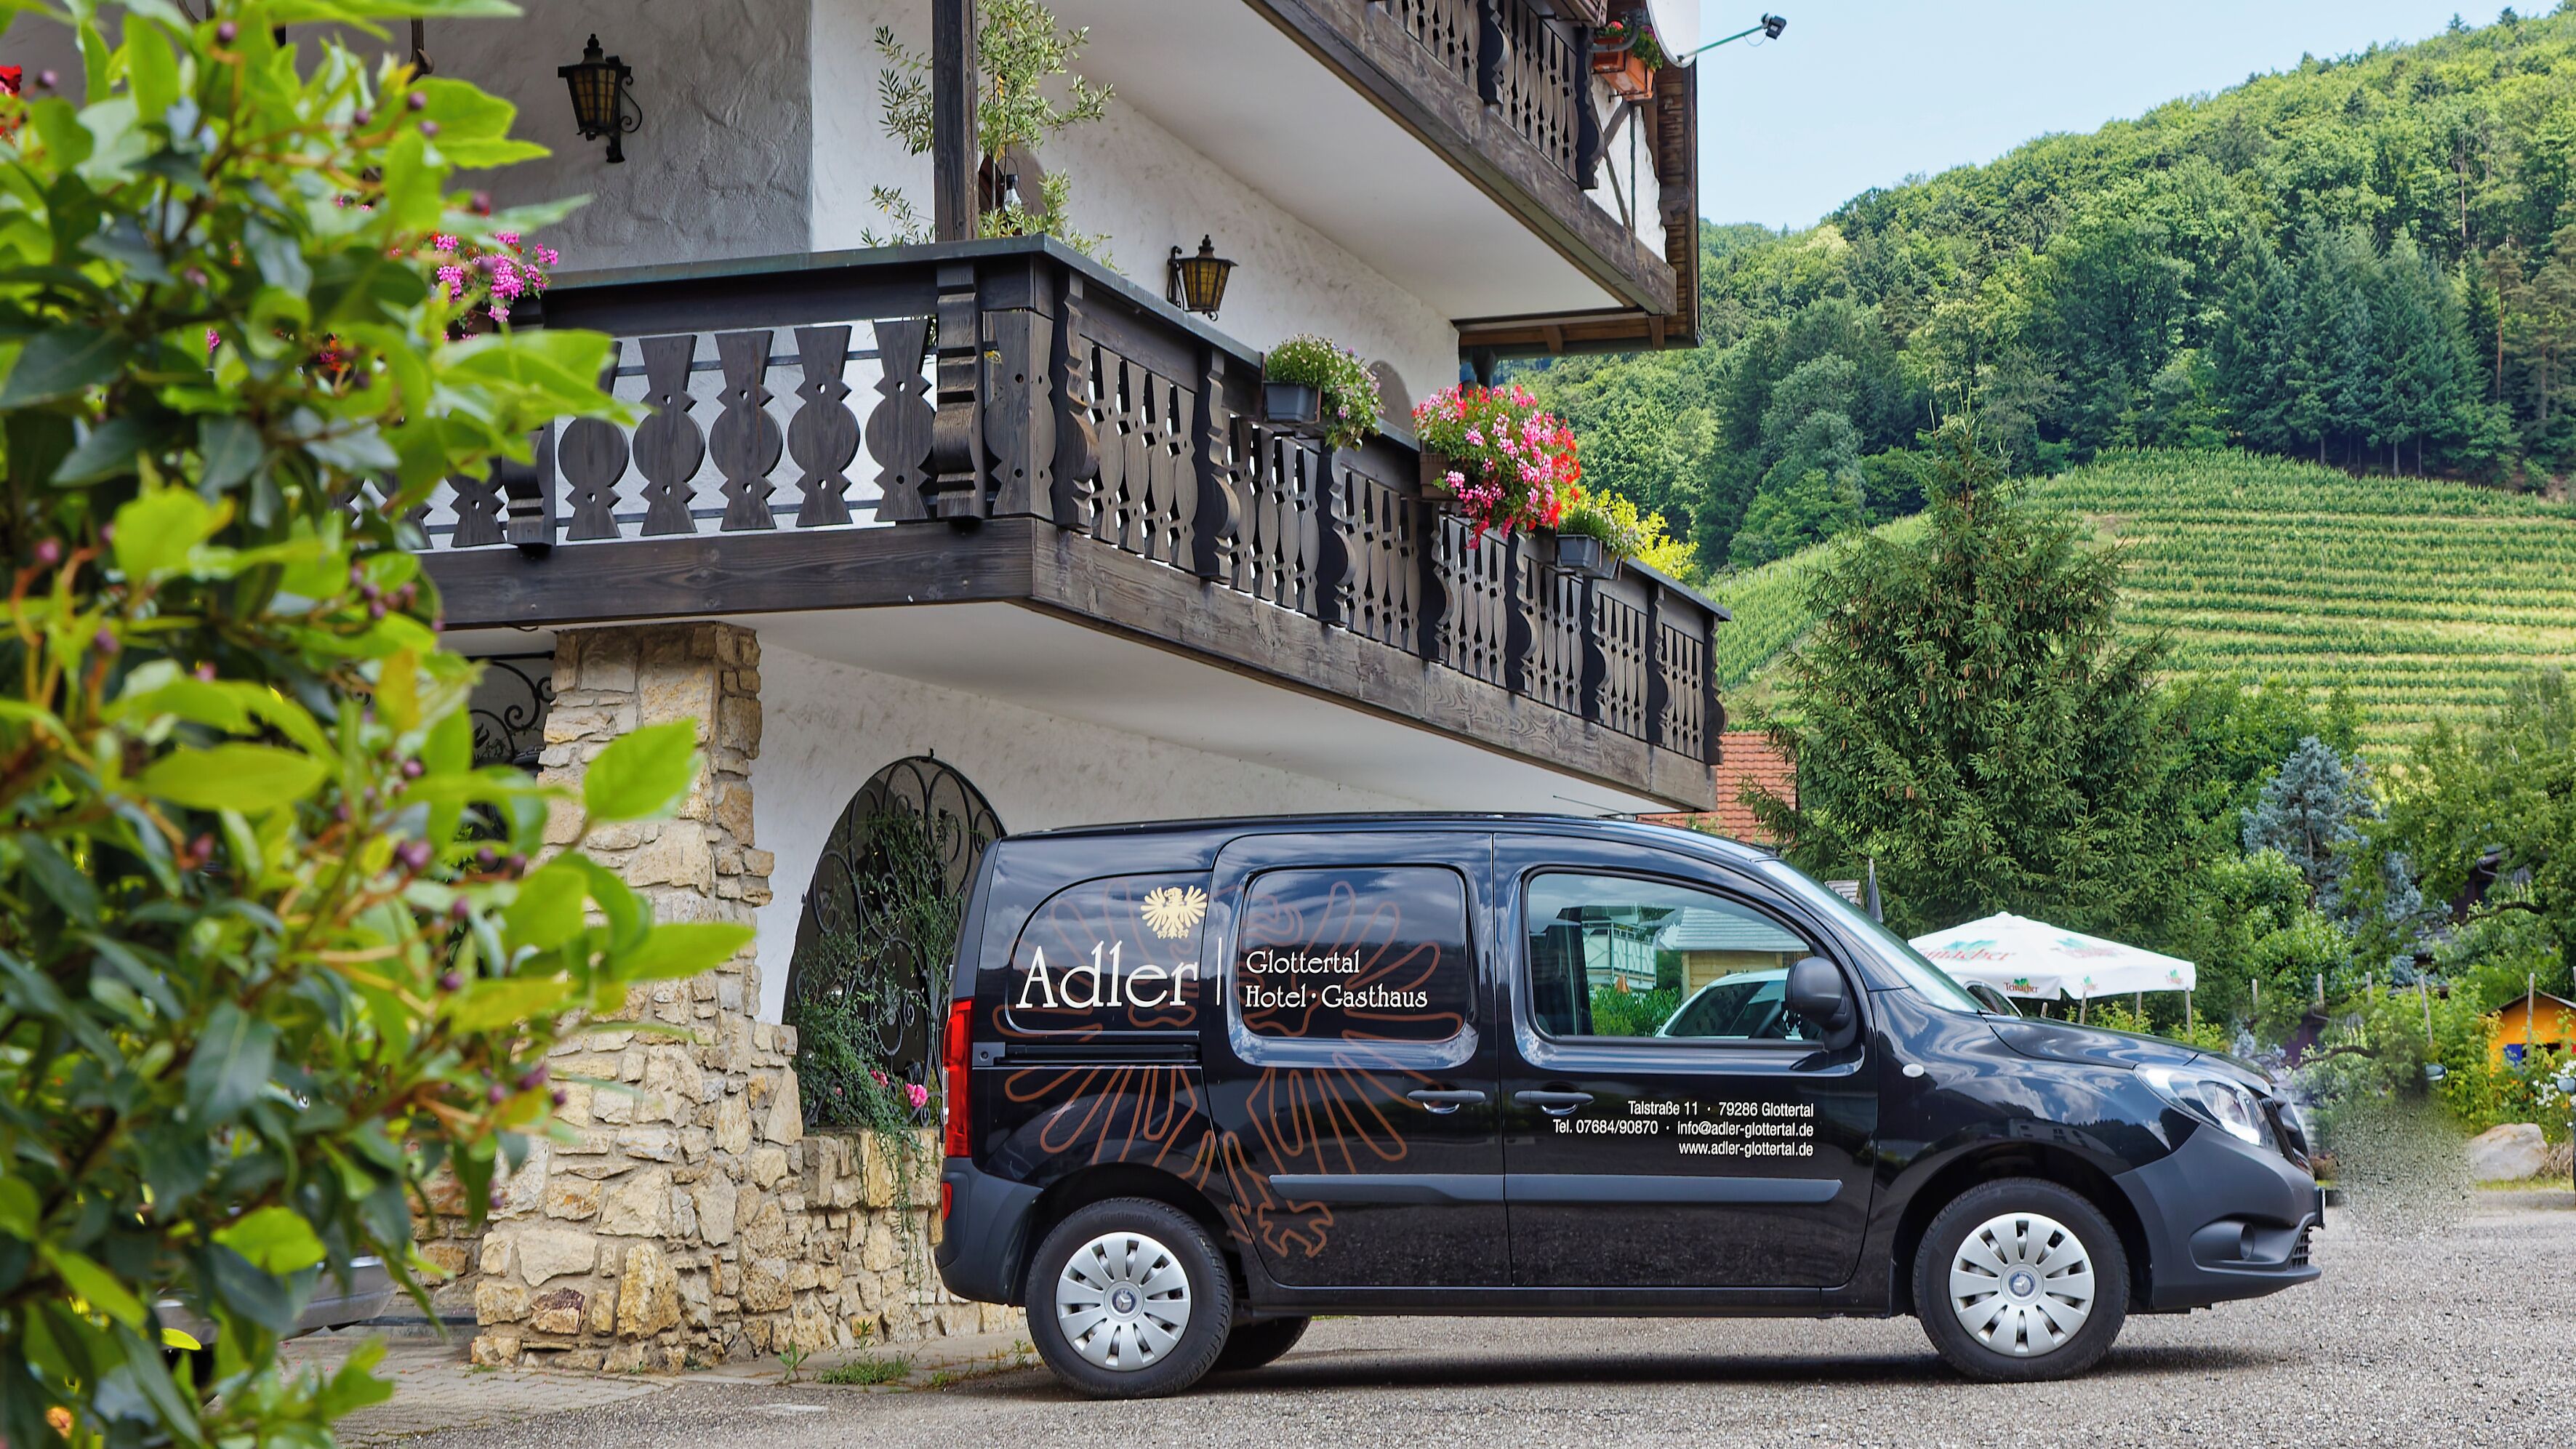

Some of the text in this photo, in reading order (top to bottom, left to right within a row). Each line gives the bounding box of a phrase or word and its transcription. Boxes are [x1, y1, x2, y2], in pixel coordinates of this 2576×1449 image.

[1245, 949, 1360, 974] Glottertal
[1014, 940, 1198, 1009] Adler
[1245, 983, 1428, 1008] Hotel Gasthaus
[1627, 1100, 1814, 1117] Talstraße 11 79286 Glottertal
[1552, 1118, 1814, 1139] Tel. 07684/90870 info@adler-glottertal.de
[1678, 1140, 1813, 1158] www.adler-glottertal.de
